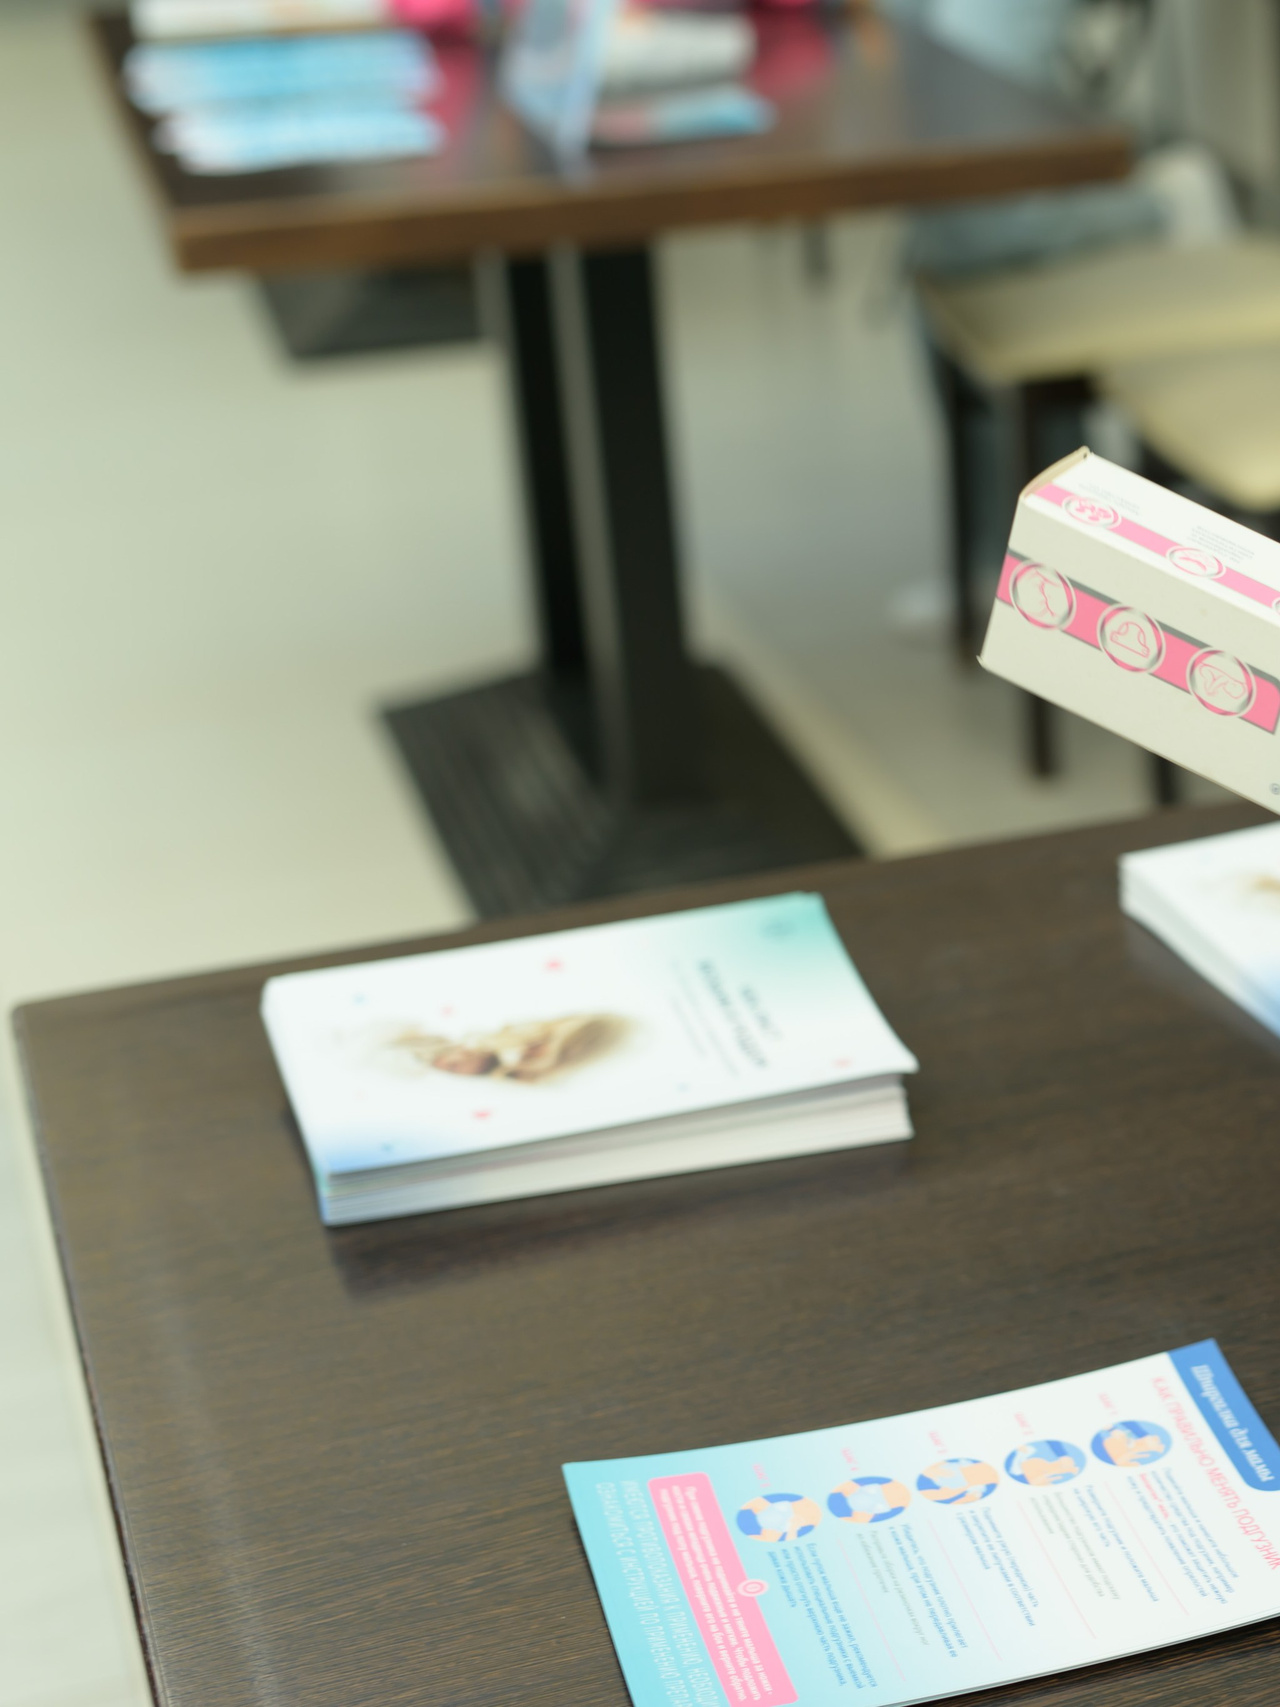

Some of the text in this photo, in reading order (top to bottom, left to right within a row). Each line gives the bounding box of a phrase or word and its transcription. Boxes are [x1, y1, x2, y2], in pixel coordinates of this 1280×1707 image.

[1149, 1375, 1177, 1399] КАК
[1165, 1401, 1216, 1467] ПРАВИЛЬНО
[1203, 1466, 1243, 1509] МЕНЯТЬ
[1188, 1363, 1276, 1482] Шпаргалка для мамы
[617, 1554, 658, 1613] ИНСТРУКЦИЕЙ
[632, 1518, 680, 1605] ПРОТИВОПОКАЗАНИЯ
[664, 1609, 703, 1668] ПРИМЕНЕНИЮ,
[637, 1610, 660, 1627] ПО
[642, 1623, 681, 1683] ПРИМЕНЕНИЮ
